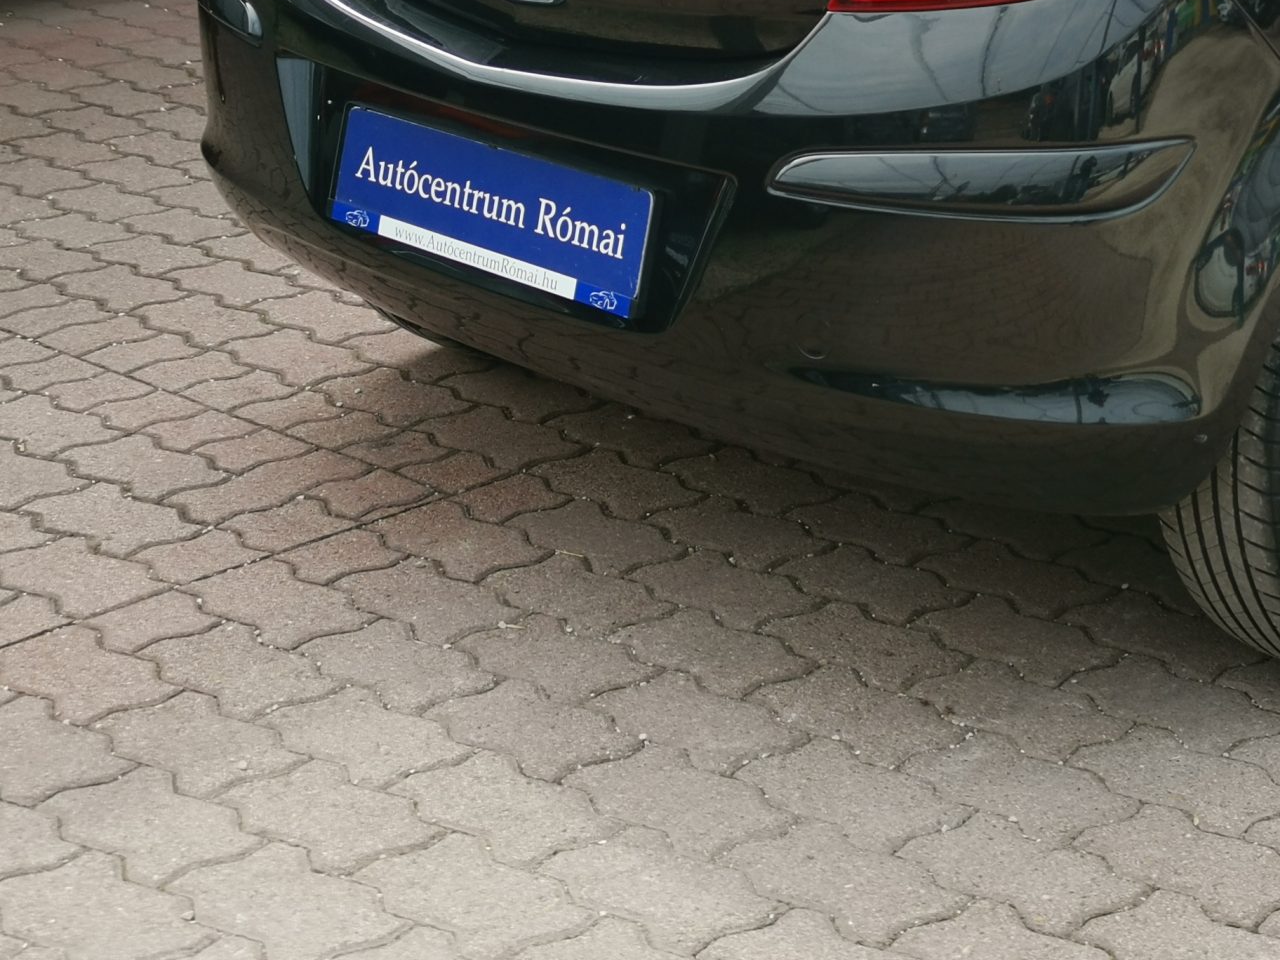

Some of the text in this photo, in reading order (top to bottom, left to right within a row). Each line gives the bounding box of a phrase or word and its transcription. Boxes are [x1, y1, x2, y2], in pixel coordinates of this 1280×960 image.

[355, 145, 627, 260] Autócentrum Római
[394, 226, 559, 291] www.AutócentrumRómai.hu
